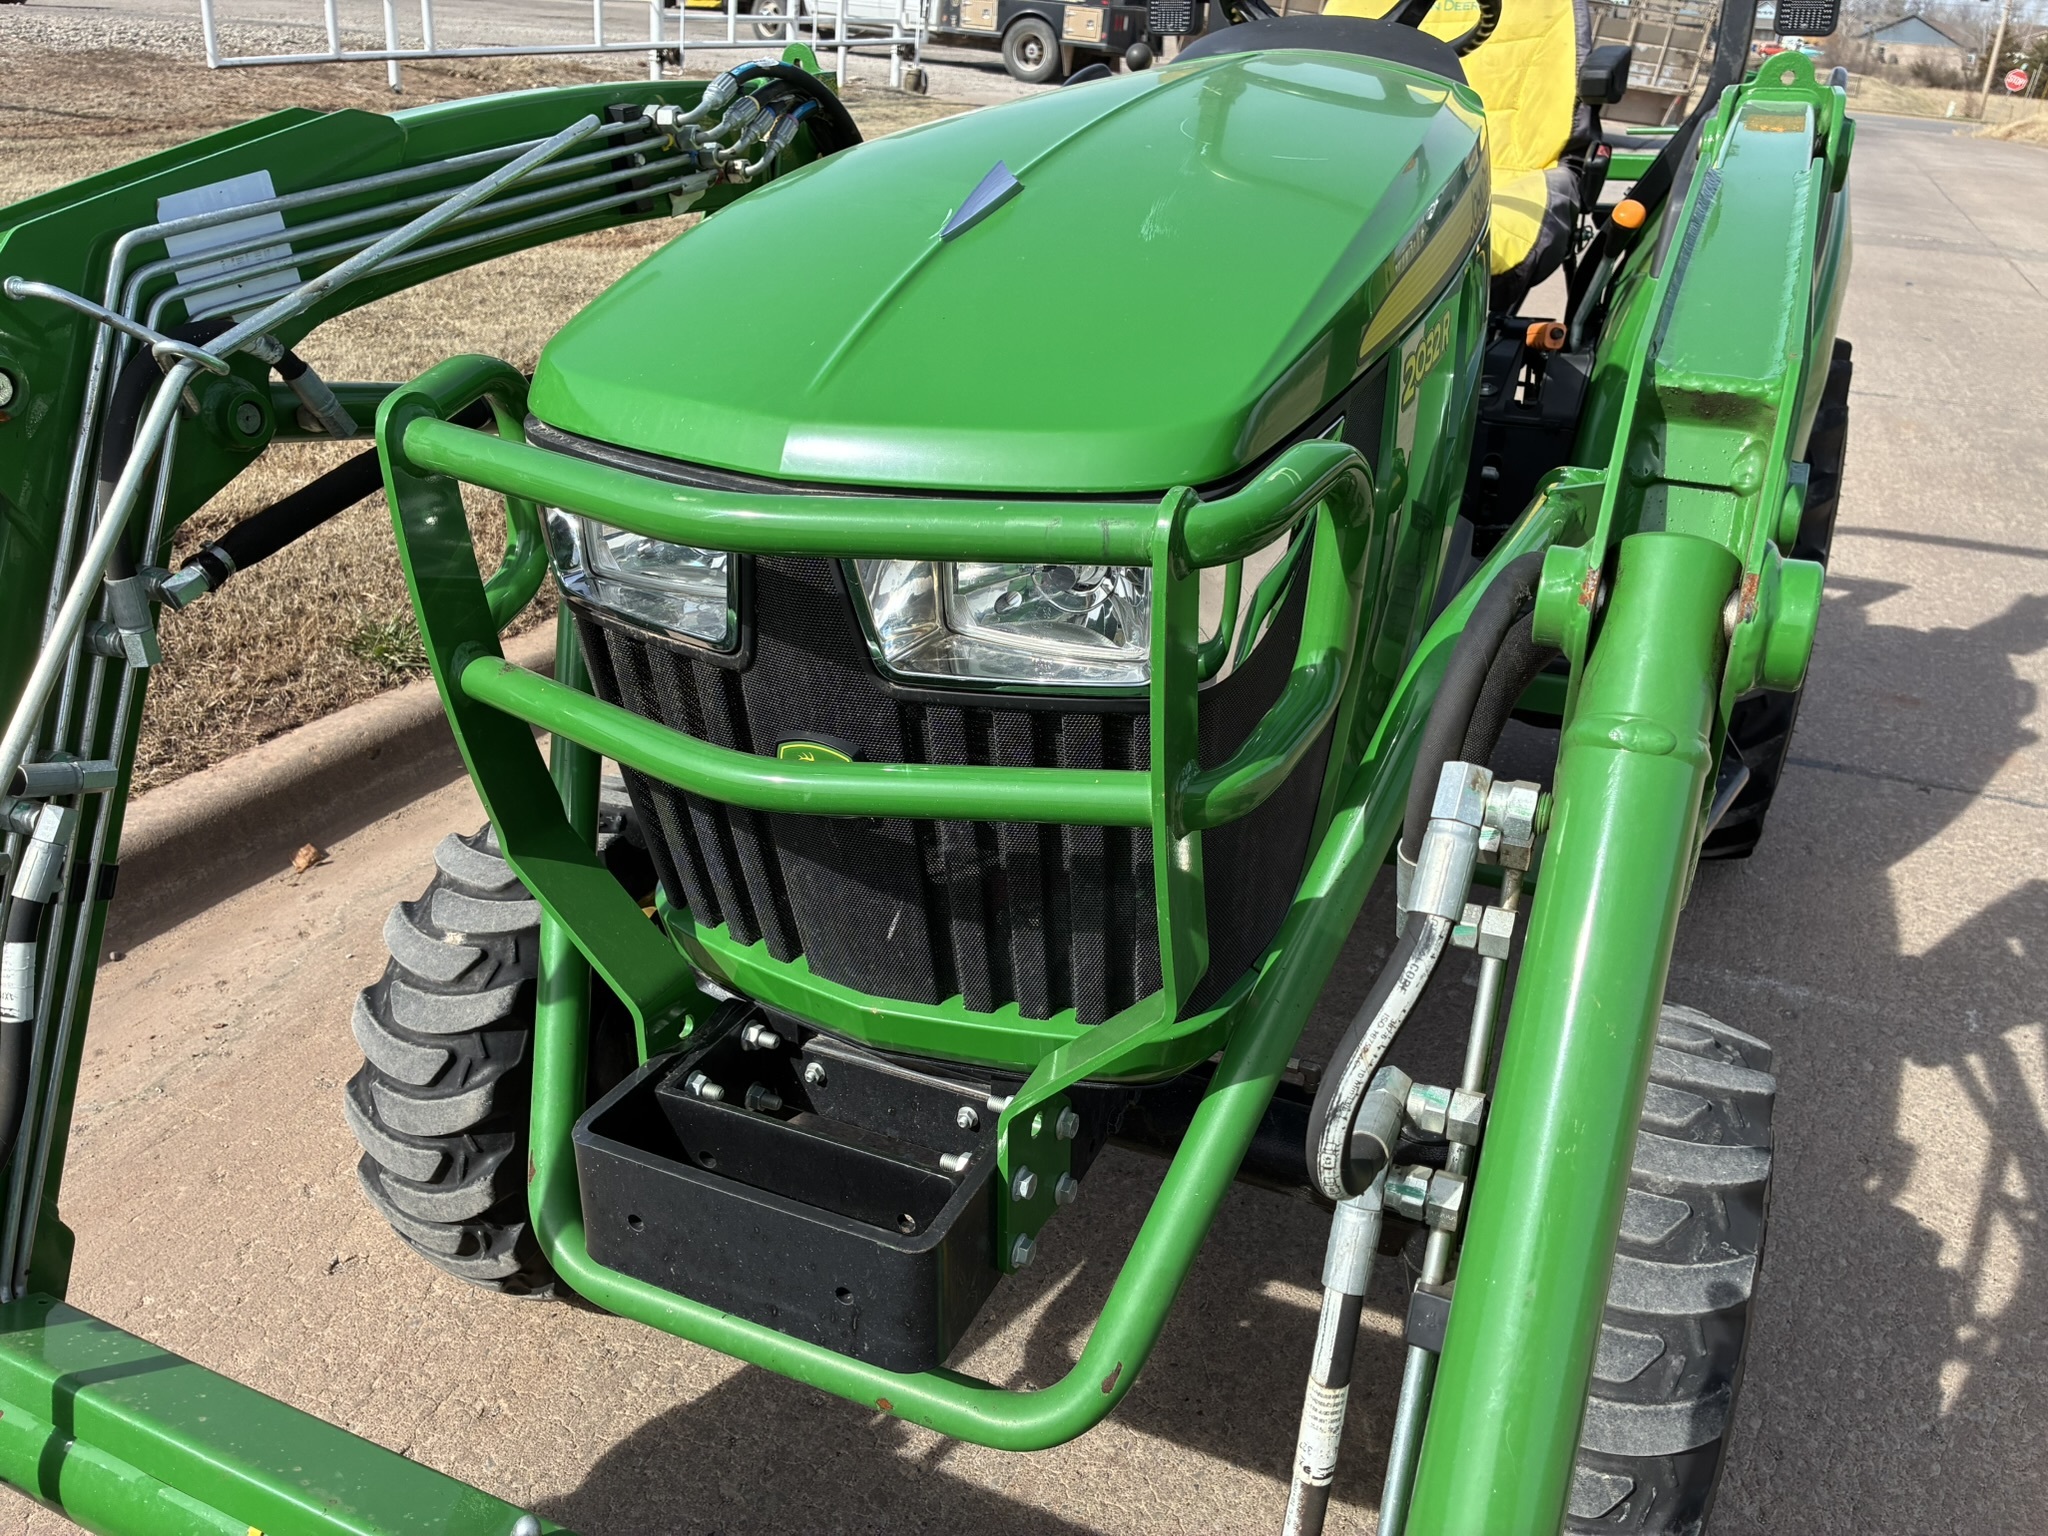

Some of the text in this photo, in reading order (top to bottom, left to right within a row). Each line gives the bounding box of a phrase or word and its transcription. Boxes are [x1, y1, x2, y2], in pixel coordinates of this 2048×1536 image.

[1444, 0, 1479, 11] DEER
[2007, 75, 2025, 86] STOP
[1402, 310, 1450, 411] 2032R
